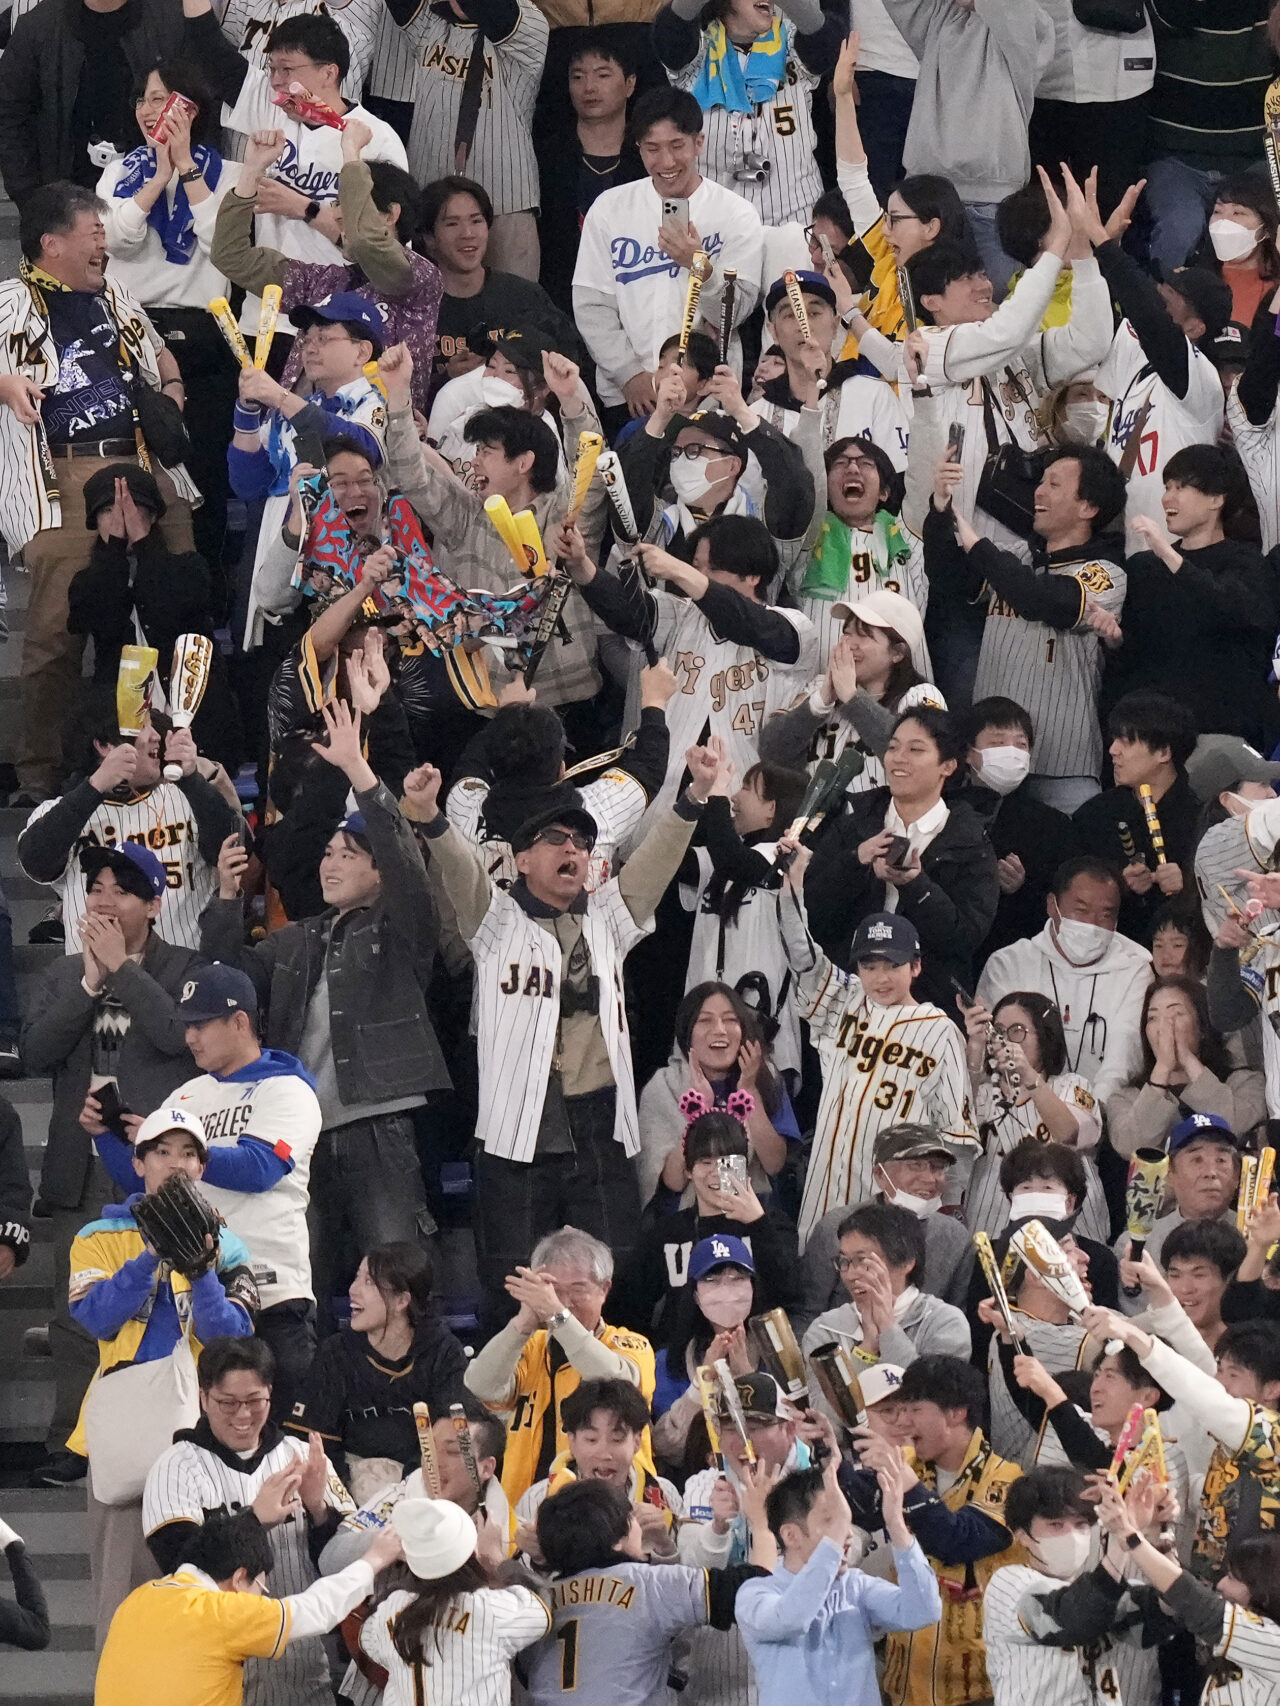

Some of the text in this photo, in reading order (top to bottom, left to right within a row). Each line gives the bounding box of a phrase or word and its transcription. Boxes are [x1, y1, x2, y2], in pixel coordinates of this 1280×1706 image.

[774, 106, 796, 136] 5
[276, 139, 341, 197] Dodger
[1268, 145, 1280, 193] HANSHIN
[789, 286, 812, 340] HANSHIN
[1045, 637, 1055, 663] 1
[674, 652, 770, 712] Tigers
[164, 860, 195, 890] 51
[835, 1013, 937, 1079] Tigers
[170, 1110, 187, 1124] LA
[873, 1079, 916, 1119] 31
[199, 1104, 253, 1142] NGELES
[1192, 1113, 1213, 1128] LA
[711, 1239, 731, 1258] LA
[882, 1368, 902, 1385] LA
[556, 1618, 579, 1693] 1
